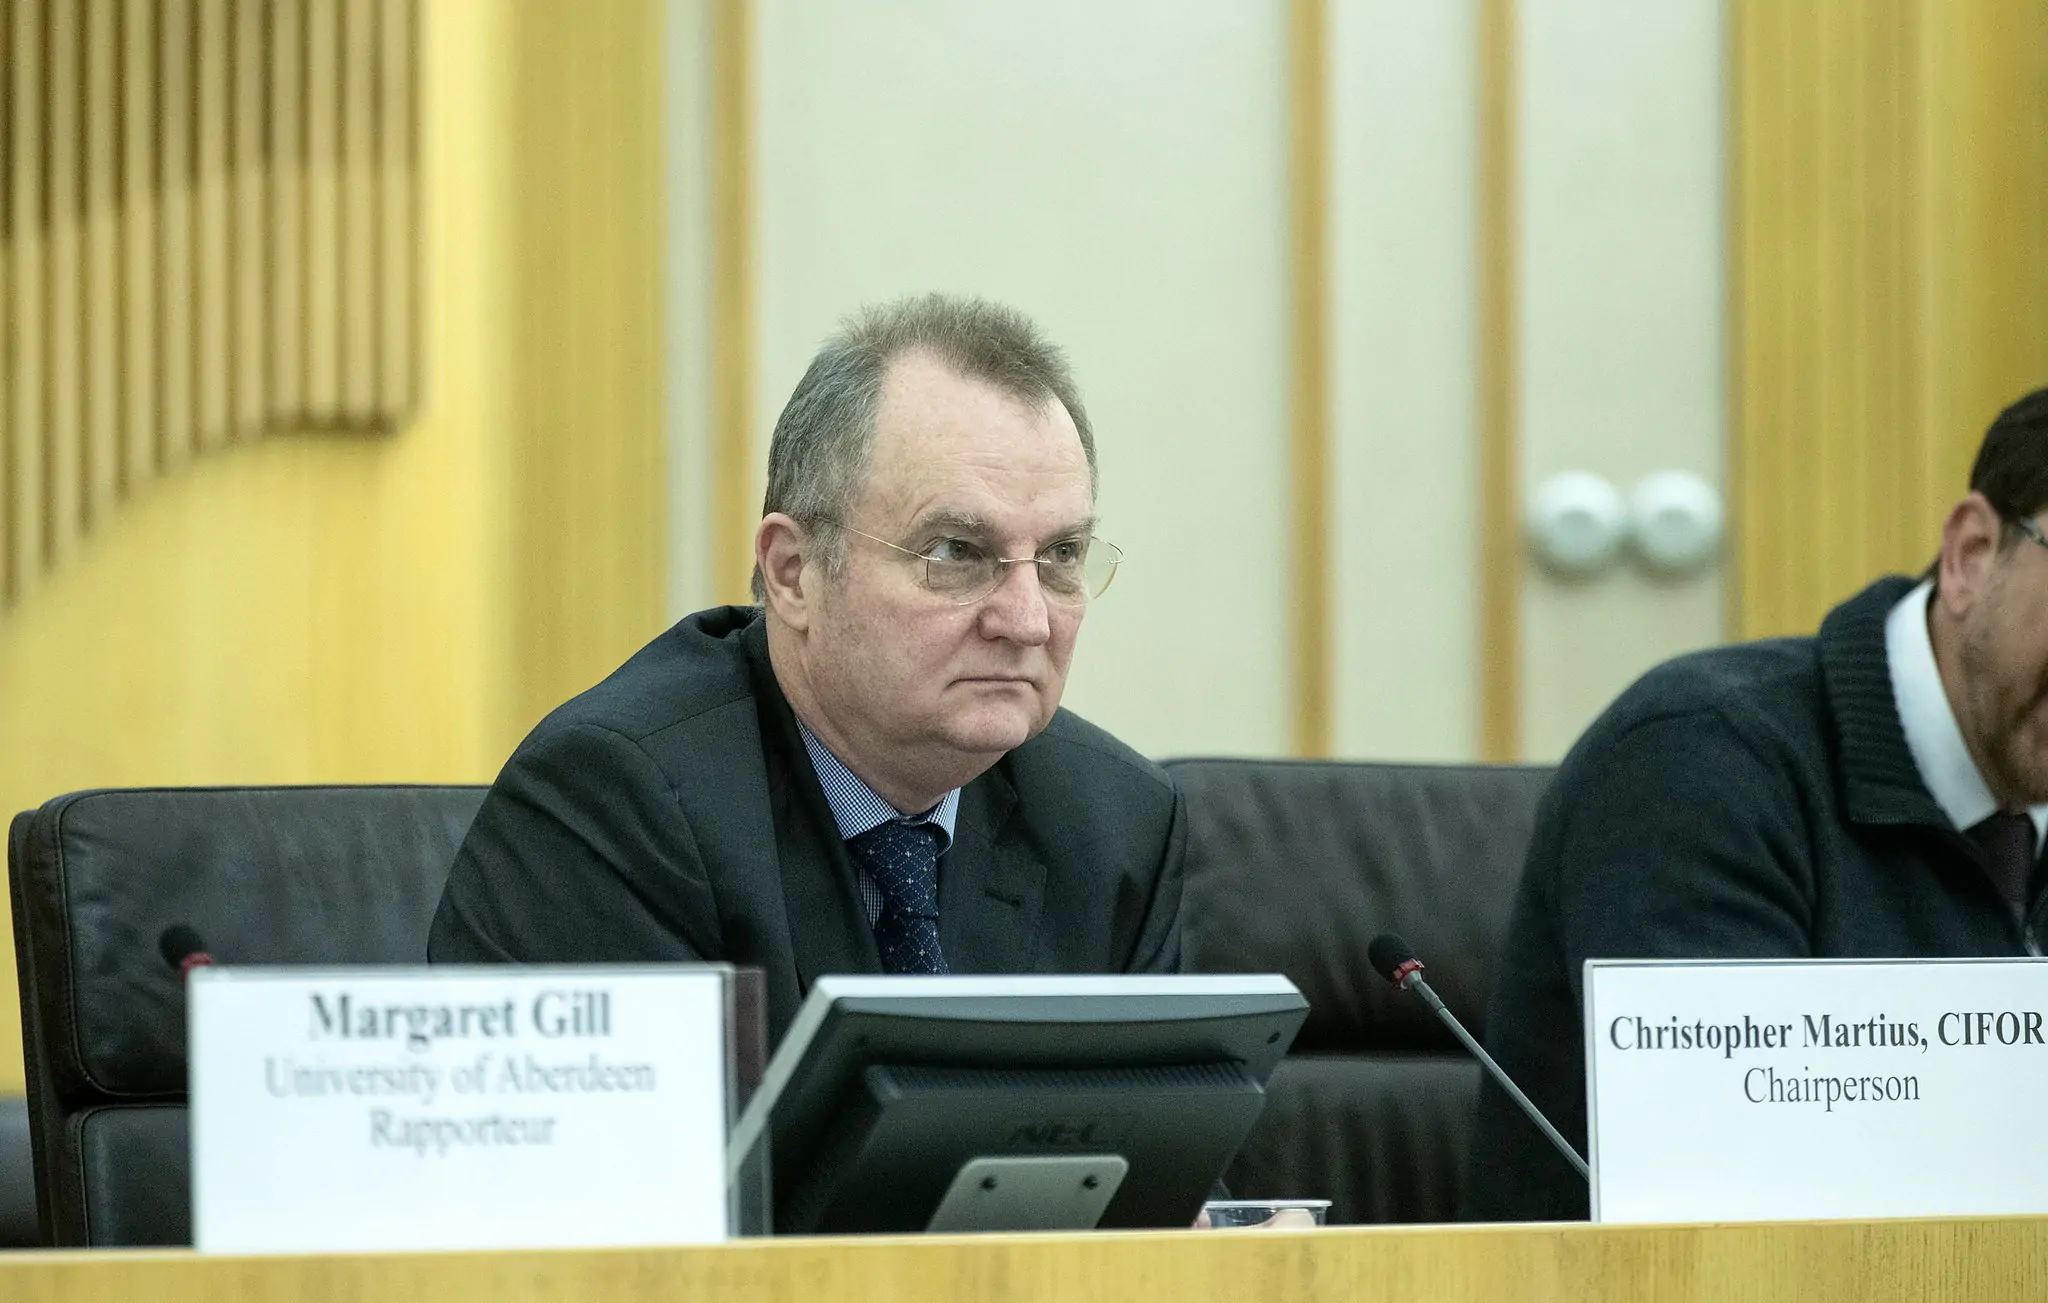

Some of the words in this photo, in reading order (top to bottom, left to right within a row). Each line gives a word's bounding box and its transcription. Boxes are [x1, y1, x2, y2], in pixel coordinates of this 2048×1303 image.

[309, 992, 516, 1051] Margaret
[532, 990, 612, 1038] Gill
[1610, 1014, 1792, 1058] Christopher
[1803, 1013, 1928, 1053] Martius,
[1937, 1011, 2046, 1046] CIFOR
[264, 1056, 440, 1103] University
[451, 1055, 490, 1096] of
[495, 1053, 655, 1094] Aberdeen
[1744, 1066, 1920, 1112] Chairperson
[369, 1109, 556, 1156] Rapporteur
[1007, 1120, 1109, 1147] NEC
